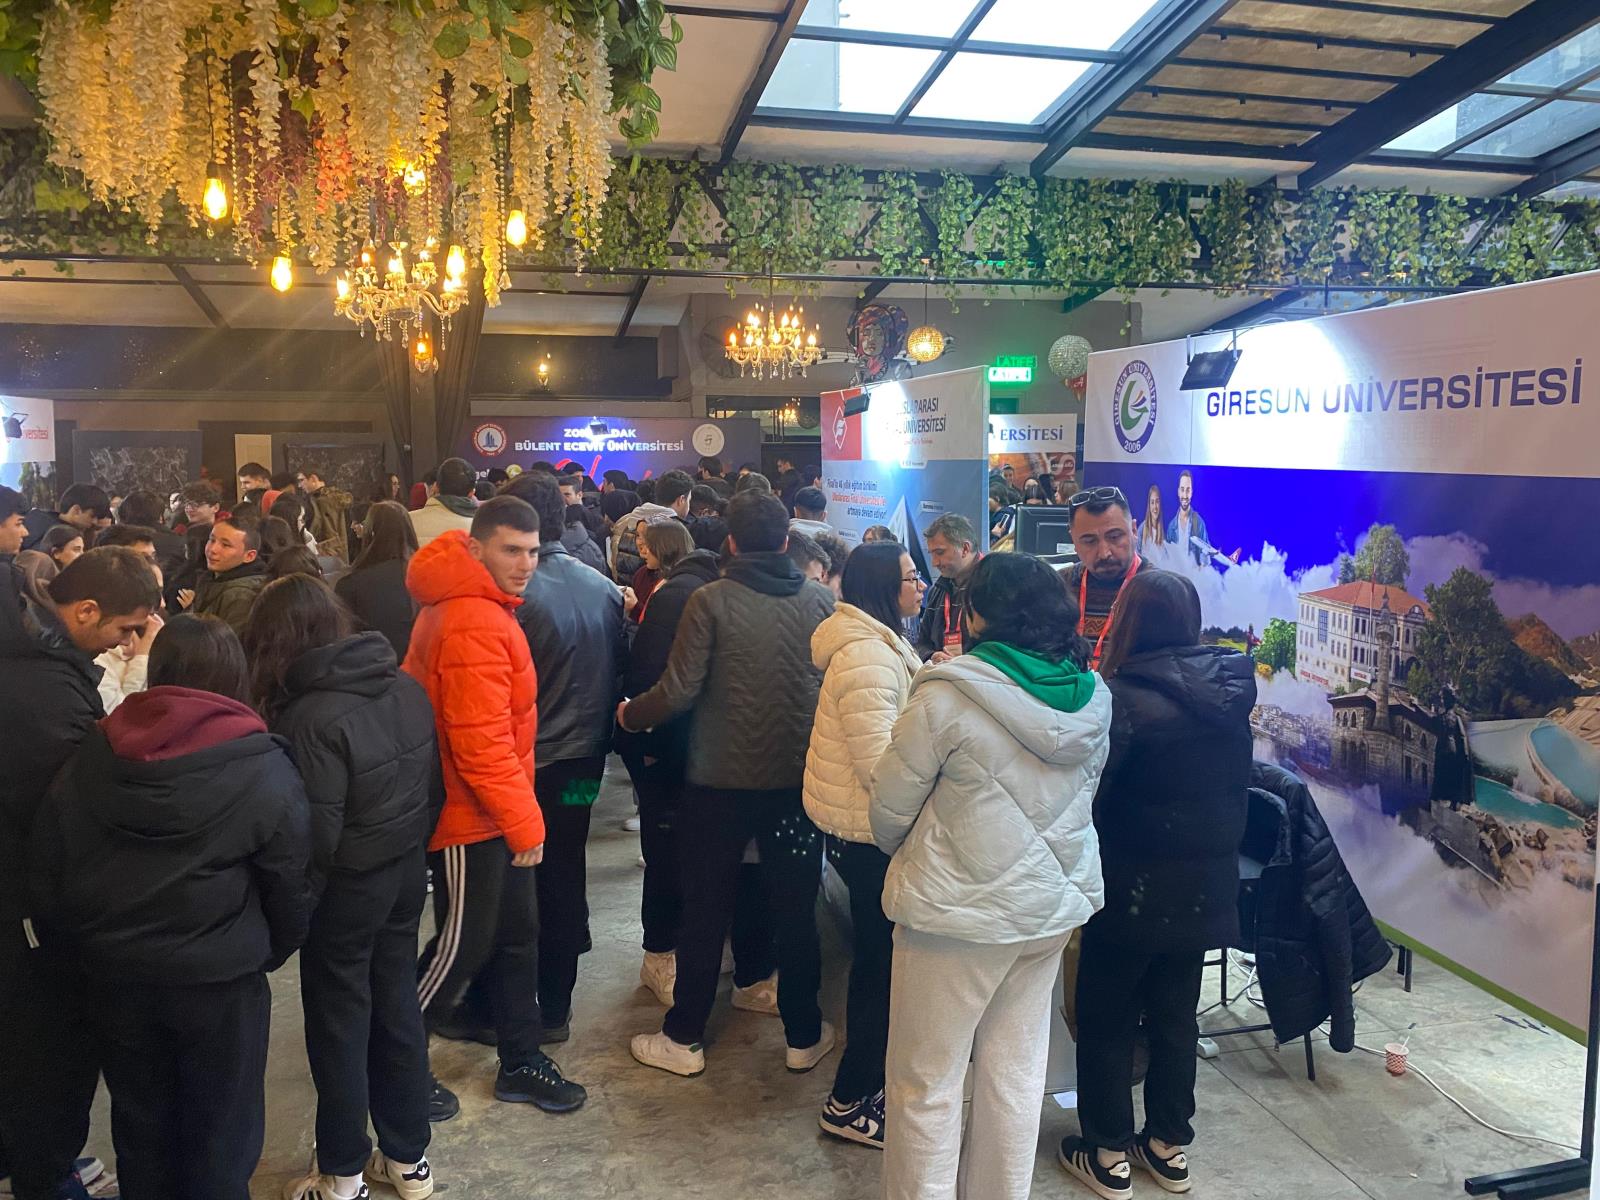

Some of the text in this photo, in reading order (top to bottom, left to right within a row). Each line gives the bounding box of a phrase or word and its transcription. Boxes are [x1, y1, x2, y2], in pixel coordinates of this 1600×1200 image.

[1000, 425, 1063, 440] ERSİTESİ
[515, 439, 561, 451] BÜLENT
[607, 439, 684, 451] ÜNİVERSİTESİ
[1124, 440, 1141, 453] 2006
